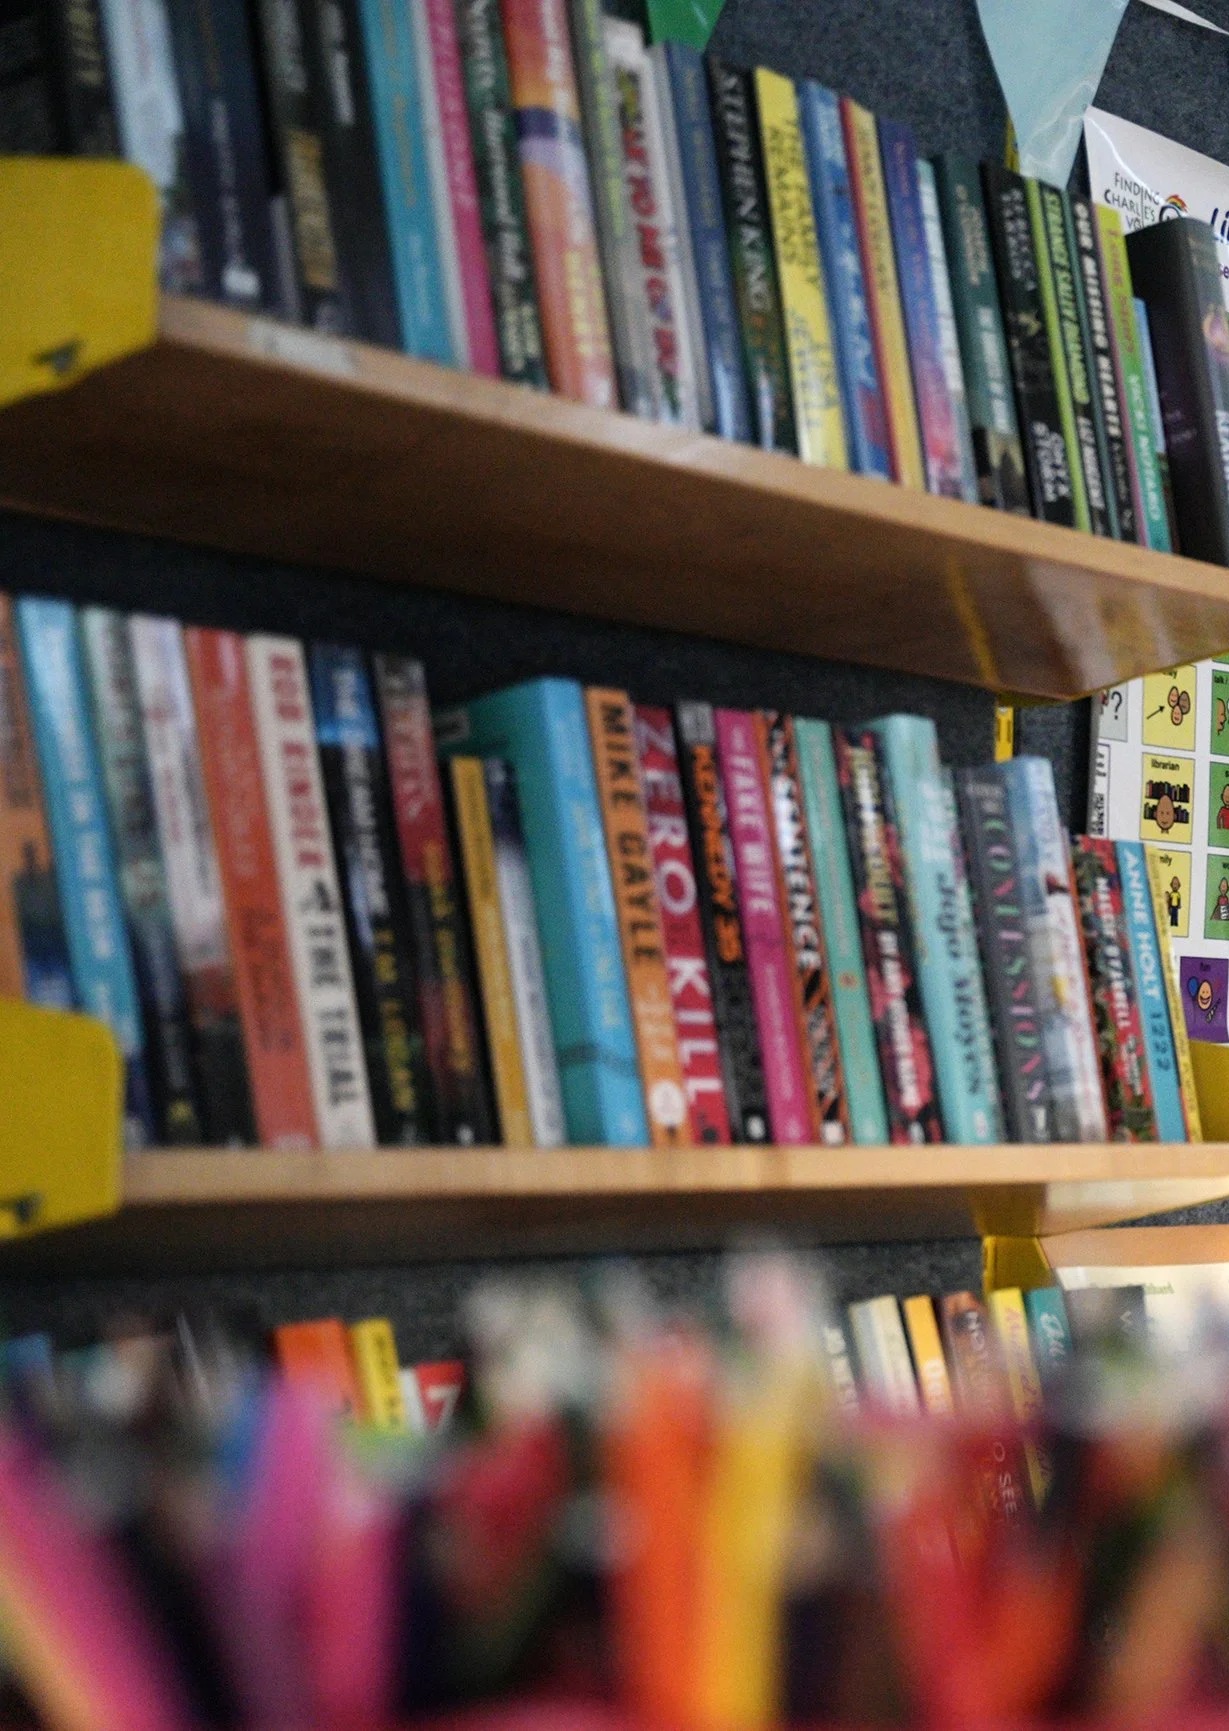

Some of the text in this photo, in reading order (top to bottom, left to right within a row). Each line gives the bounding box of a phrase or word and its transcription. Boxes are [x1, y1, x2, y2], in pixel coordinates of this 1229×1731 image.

[1104, 189, 1155, 222] CHARLIE'S
[1115, 173, 1160, 205] FINDING
[740, 223, 774, 314] KING
[1079, 252, 1110, 350] MISSING
[600, 699, 638, 809] MIKE
[632, 713, 701, 918] ZERO
[727, 751, 764, 837] FAKE
[1151, 759, 1180, 771] librarian
[616, 827, 661, 964] GAYLE
[686, 743, 744, 964] KENNEDY 35
[737, 839, 776, 919] WIFE
[303, 924, 360, 1107] THE TRIAL
[930, 871, 988, 1096] Jojo Moyes
[979, 815, 1050, 1102] CONFESSIONS
[1123, 847, 1171, 1073] ANNE HOLT 1222
[664, 952, 727, 1105] KILL
